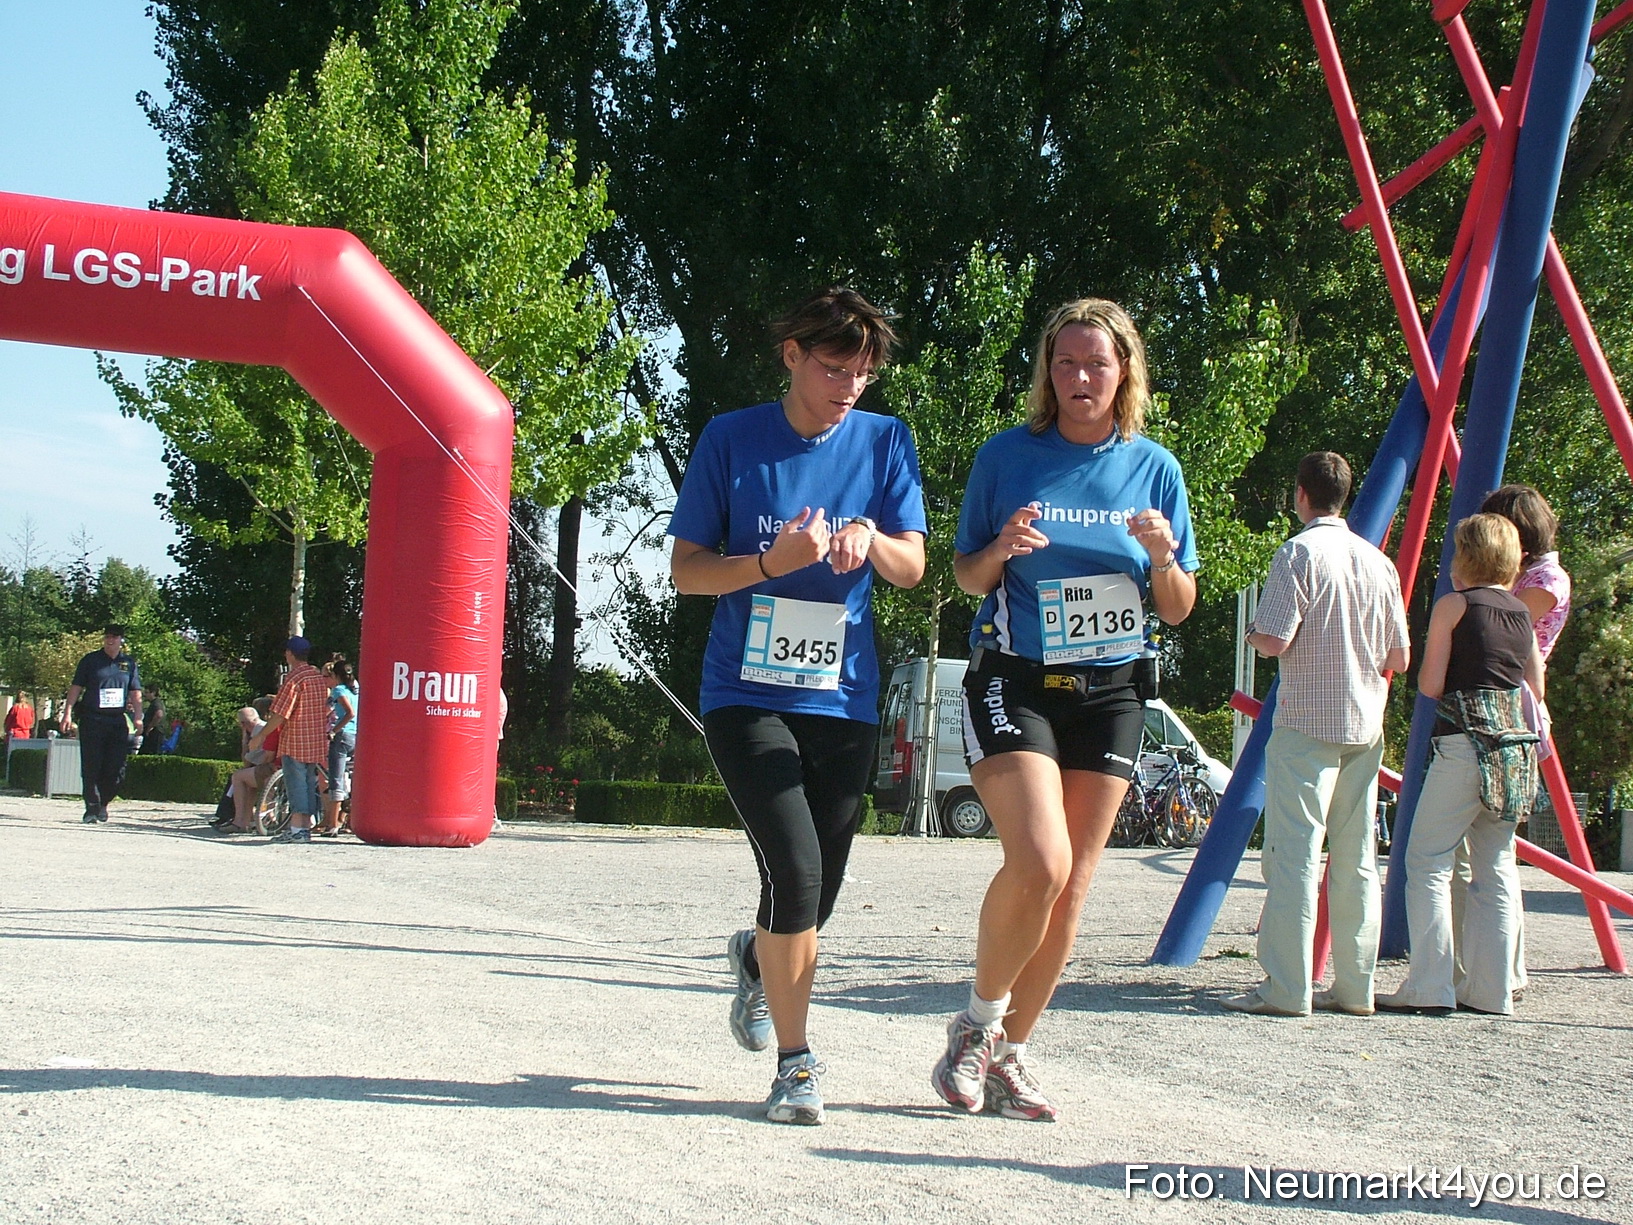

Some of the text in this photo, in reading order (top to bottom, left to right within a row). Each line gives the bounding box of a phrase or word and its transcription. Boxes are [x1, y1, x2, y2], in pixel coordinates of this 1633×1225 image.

[43, 243, 262, 302] LGS-Park
[1064, 587, 1093, 602] Rita
[1046, 611, 1057, 624] D
[1069, 608, 1136, 639] 2136
[773, 636, 837, 665] 3455
[392, 661, 478, 704] Braun
[426, 705, 482, 718] Sicher ist sicher
